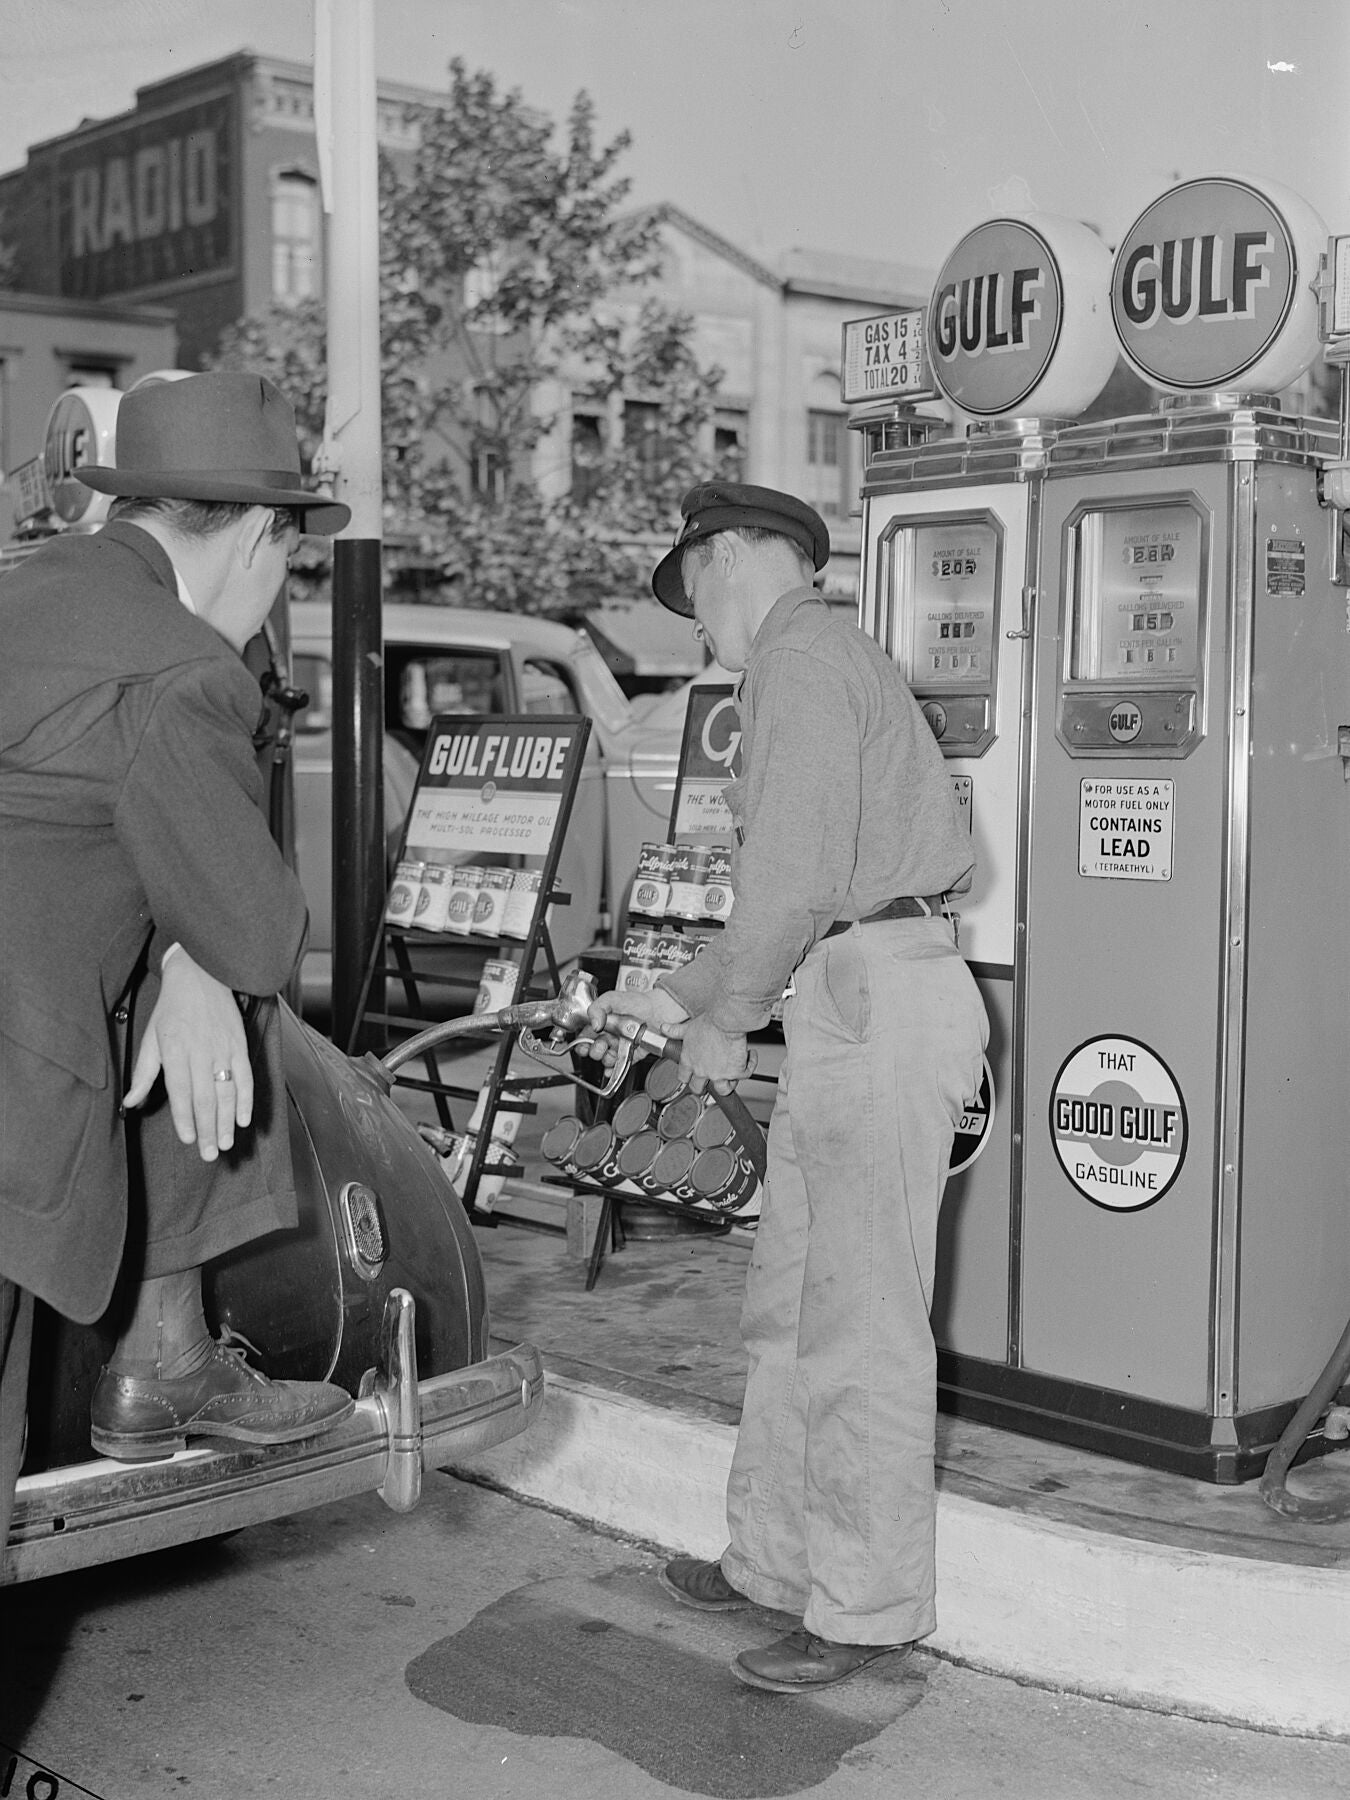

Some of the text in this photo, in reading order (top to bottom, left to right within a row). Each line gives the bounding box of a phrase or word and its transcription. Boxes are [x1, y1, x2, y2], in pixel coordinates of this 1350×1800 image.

[71, 129, 217, 258] RADIO
[1122, 231, 1275, 330] GULF
[934, 267, 1045, 362] GULF
[865, 318, 908, 344] GAS 15
[865, 340, 907, 366] TAX 4
[864, 365, 908, 391] TOTAL 20
[1110, 713, 1139, 730] GULF
[428, 734, 571, 779] GULFLUBE
[687, 794, 705, 805] THE
[1095, 785, 1160, 796] FOR USE AS A
[1085, 799, 1170, 811] MOTOR FUEL ONLY
[417, 809, 552, 827] THE HIGH MILEAGE MOTOR OIL
[1089, 816, 1162, 833] CONTAINS
[479, 826, 533, 838] PROCESSED
[1100, 837, 1151, 858] LEAD
[1094, 861, 1155, 874] (TETRAETHYL)
[1098, 1052, 1136, 1072] THAT
[1056, 1098, 1179, 1147] GOOD GULF
[1075, 1162, 1158, 1190] GASOLINE
